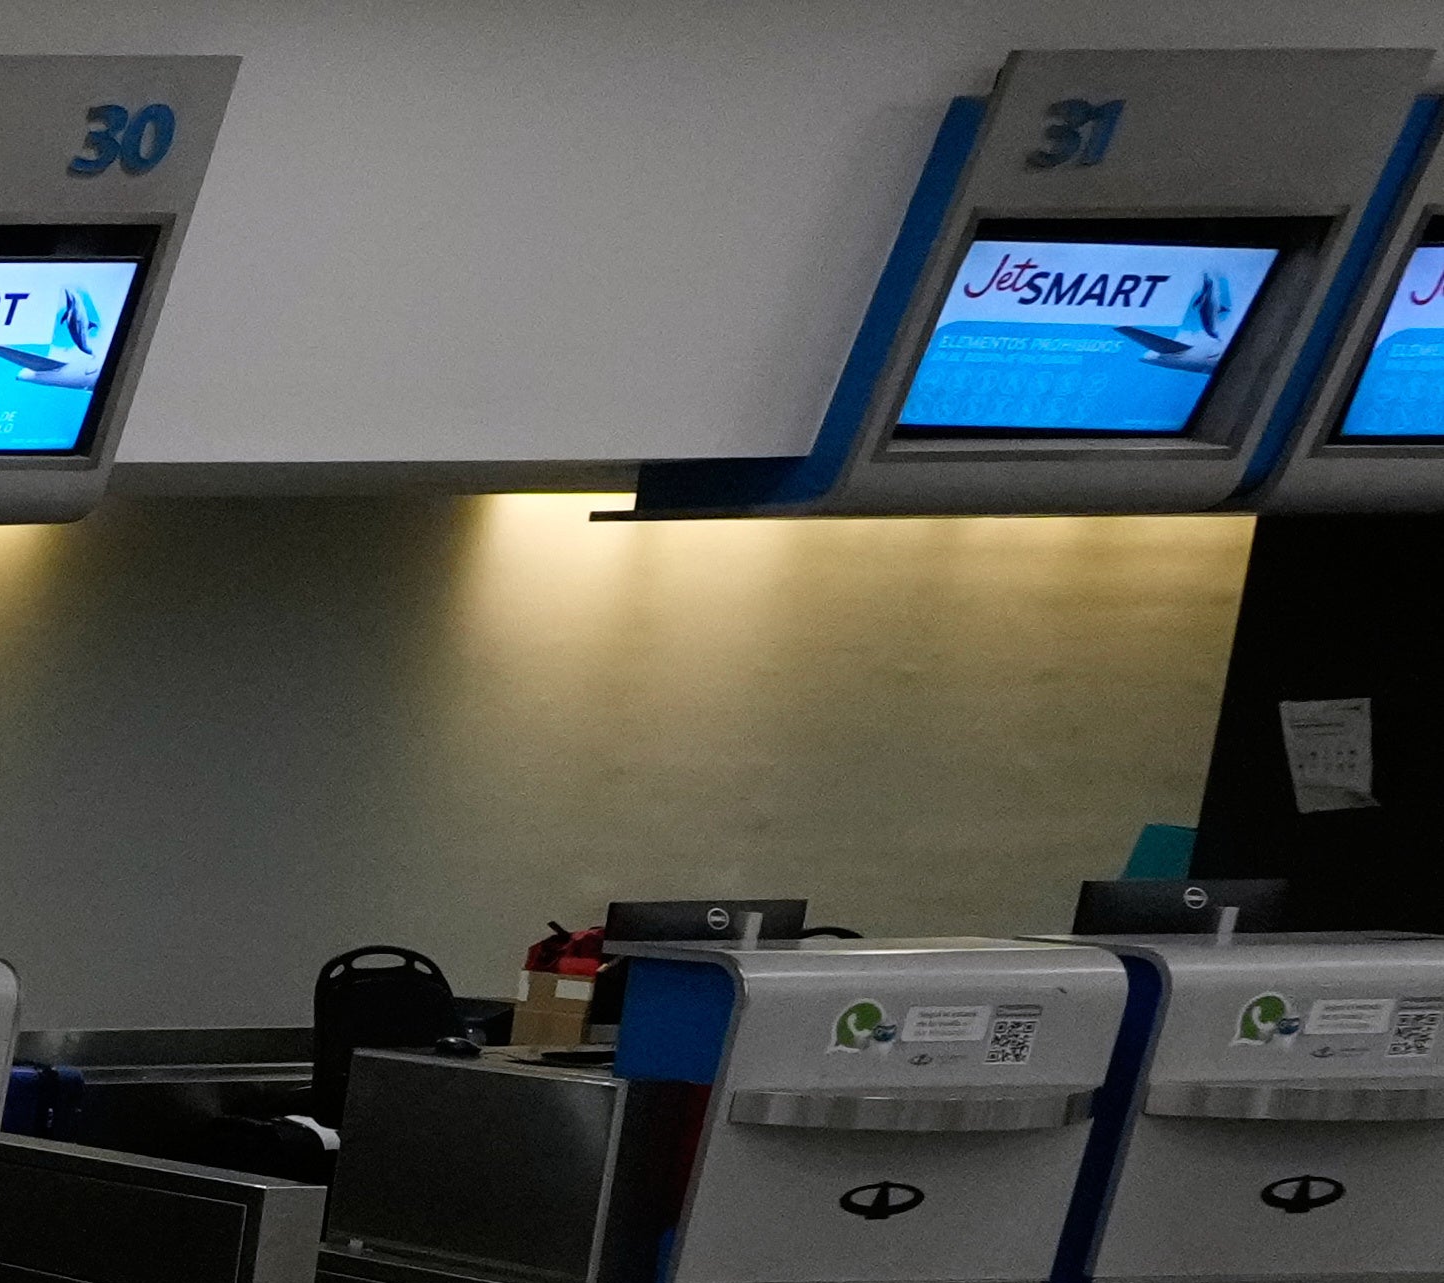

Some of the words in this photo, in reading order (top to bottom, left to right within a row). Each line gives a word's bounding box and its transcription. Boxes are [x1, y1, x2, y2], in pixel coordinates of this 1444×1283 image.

[68, 103, 175, 179] 30
[1026, 99, 1126, 170] 31
[964, 253, 1170, 308] JetSMART
[938, 336, 1027, 352] ELEMENTOS
[0, 411, 17, 422] DE
